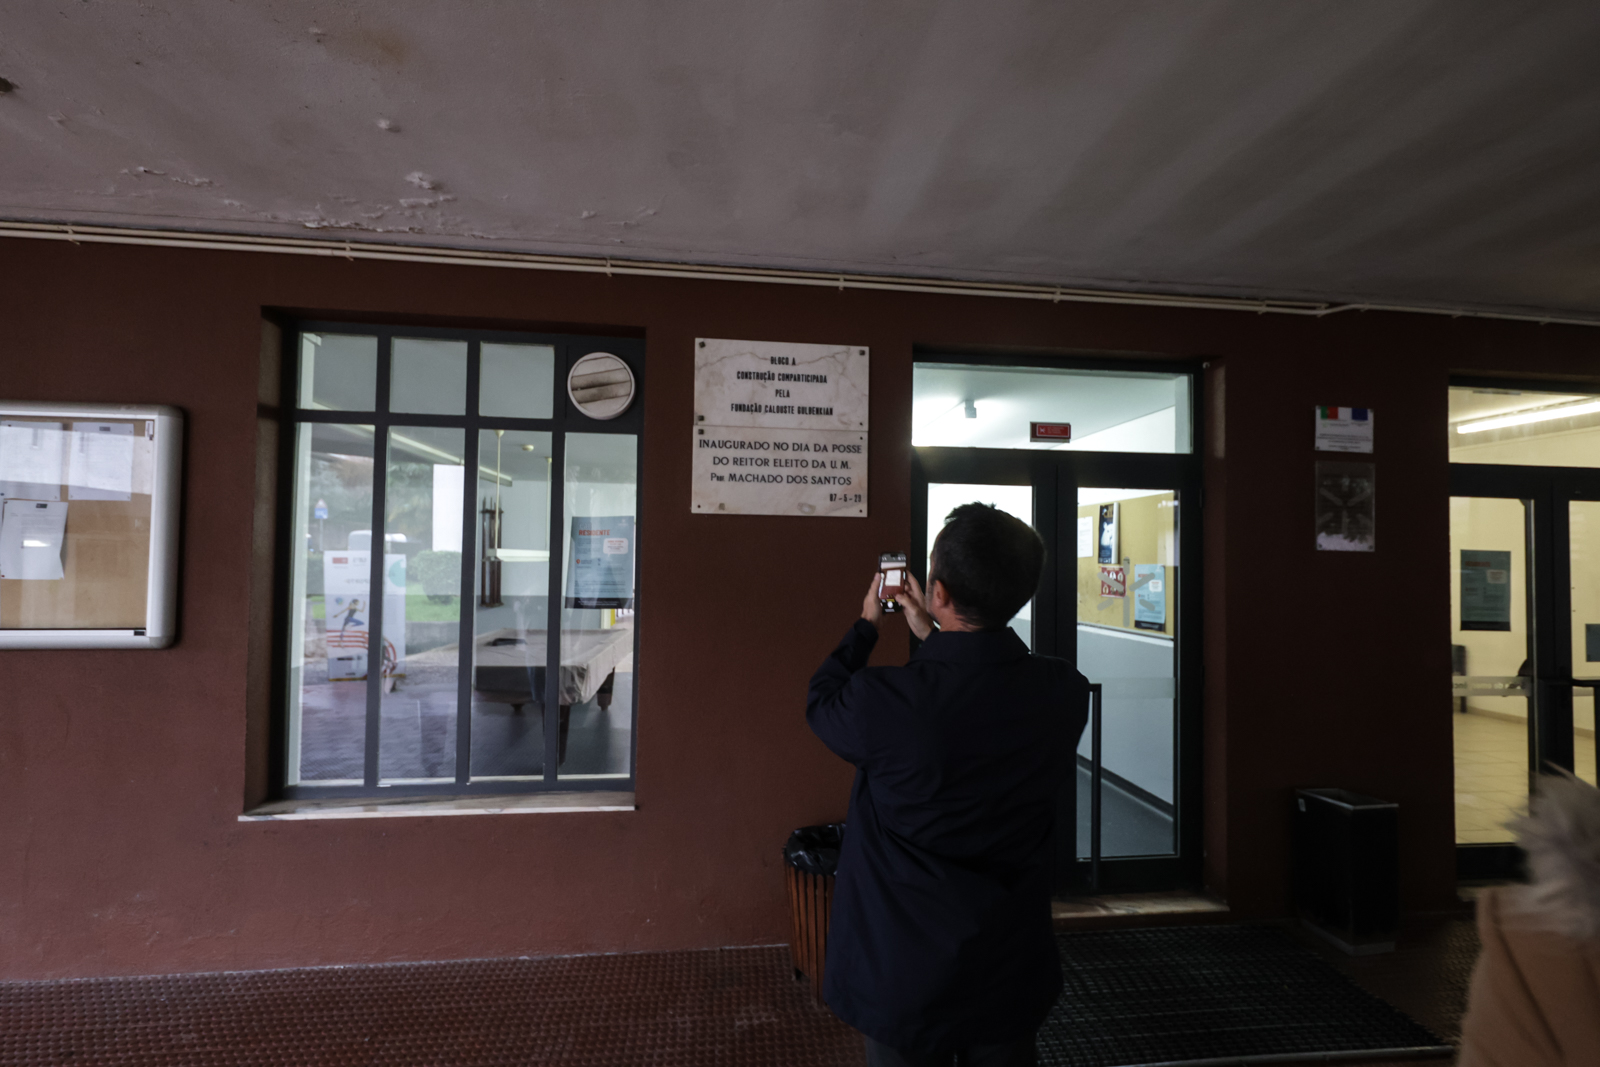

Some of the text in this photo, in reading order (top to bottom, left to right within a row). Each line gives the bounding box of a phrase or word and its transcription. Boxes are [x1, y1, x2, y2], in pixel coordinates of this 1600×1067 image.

[770, 356, 796, 366] BLOCO A
[737, 371, 827, 383] CONSTRUÇÃO COMPARTICIPADA
[775, 389, 790, 398] PELA
[731, 403, 833, 416] FUNDAÇÃO CALOUSTE GULBENKIAN
[699, 439, 862, 454] INAUGURADO NO DIA DA POSSE
[713, 456, 729, 466] DO
[733, 457, 770, 467] REITOR
[773, 458, 809, 468] ELEITO
[812, 460, 826, 469] DA
[728, 473, 783, 483] MACHADO
[786, 475, 808, 484] DOS
[811, 476, 852, 486] SANTOS
